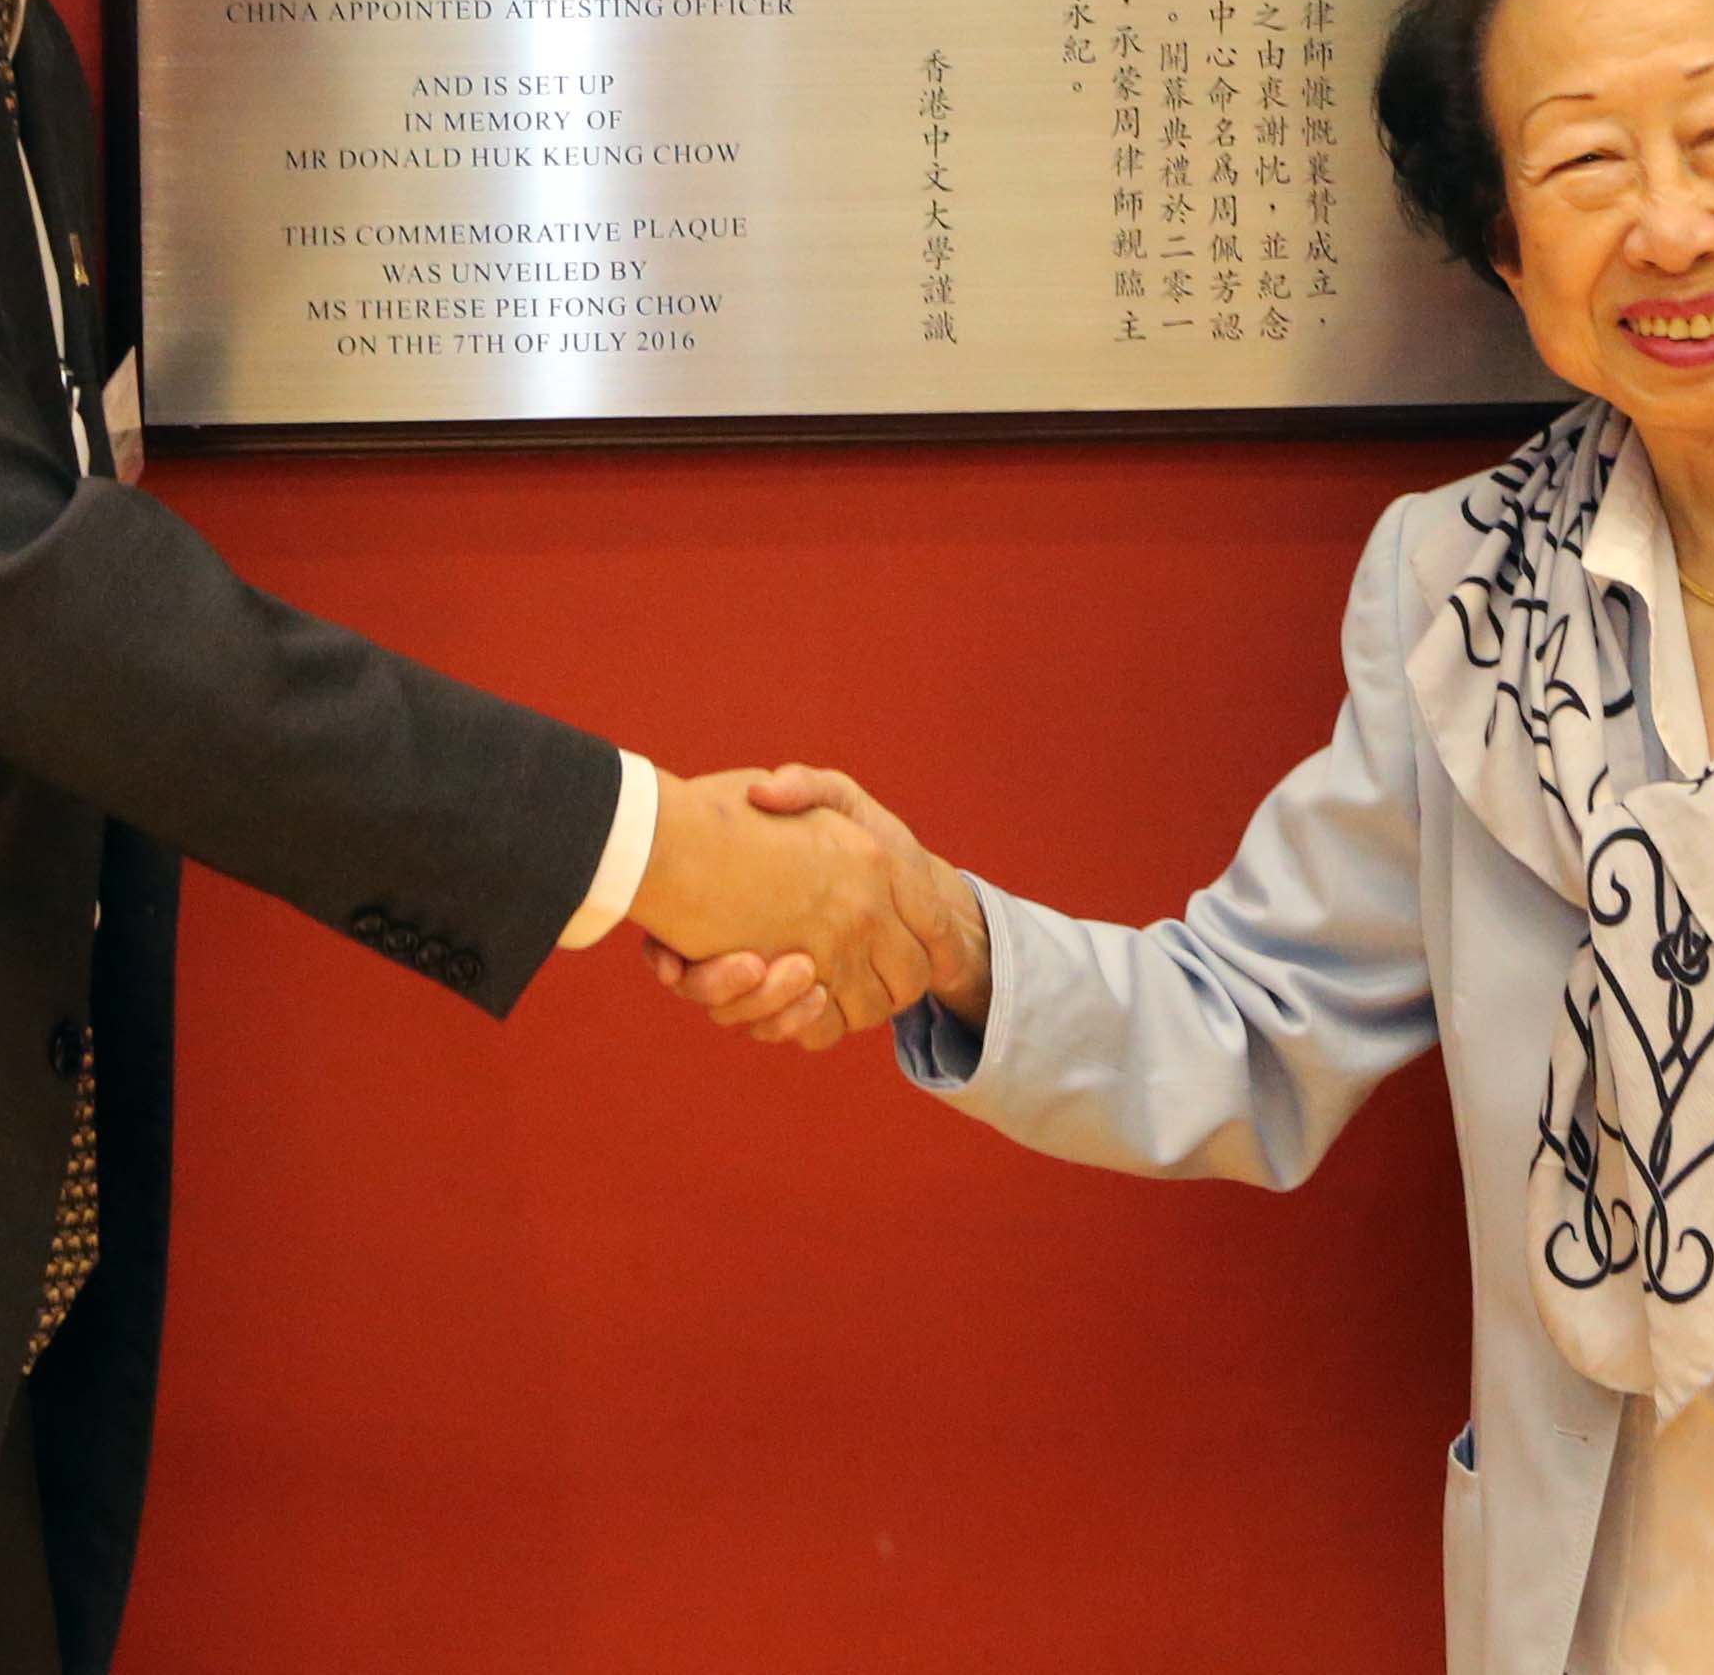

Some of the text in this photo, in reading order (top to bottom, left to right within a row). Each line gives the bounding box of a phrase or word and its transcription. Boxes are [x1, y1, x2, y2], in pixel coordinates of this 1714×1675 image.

[225, 1, 318, 24] CHINA
[411, 74, 615, 98] AND IS SET UP
[404, 109, 623, 133] IN MEMORY OF
[285, 141, 741, 171] MR DONALD HUK KEUNG CHOW
[280, 216, 747, 247] THIS COMMEMORATIVE PLAQUE
[381, 260, 647, 284] WAS UNVEILED BY
[307, 293, 723, 321] MS THERESE PEI FONG CHOW
[337, 330, 695, 357] ON THE 7TH OF JULY 2016
